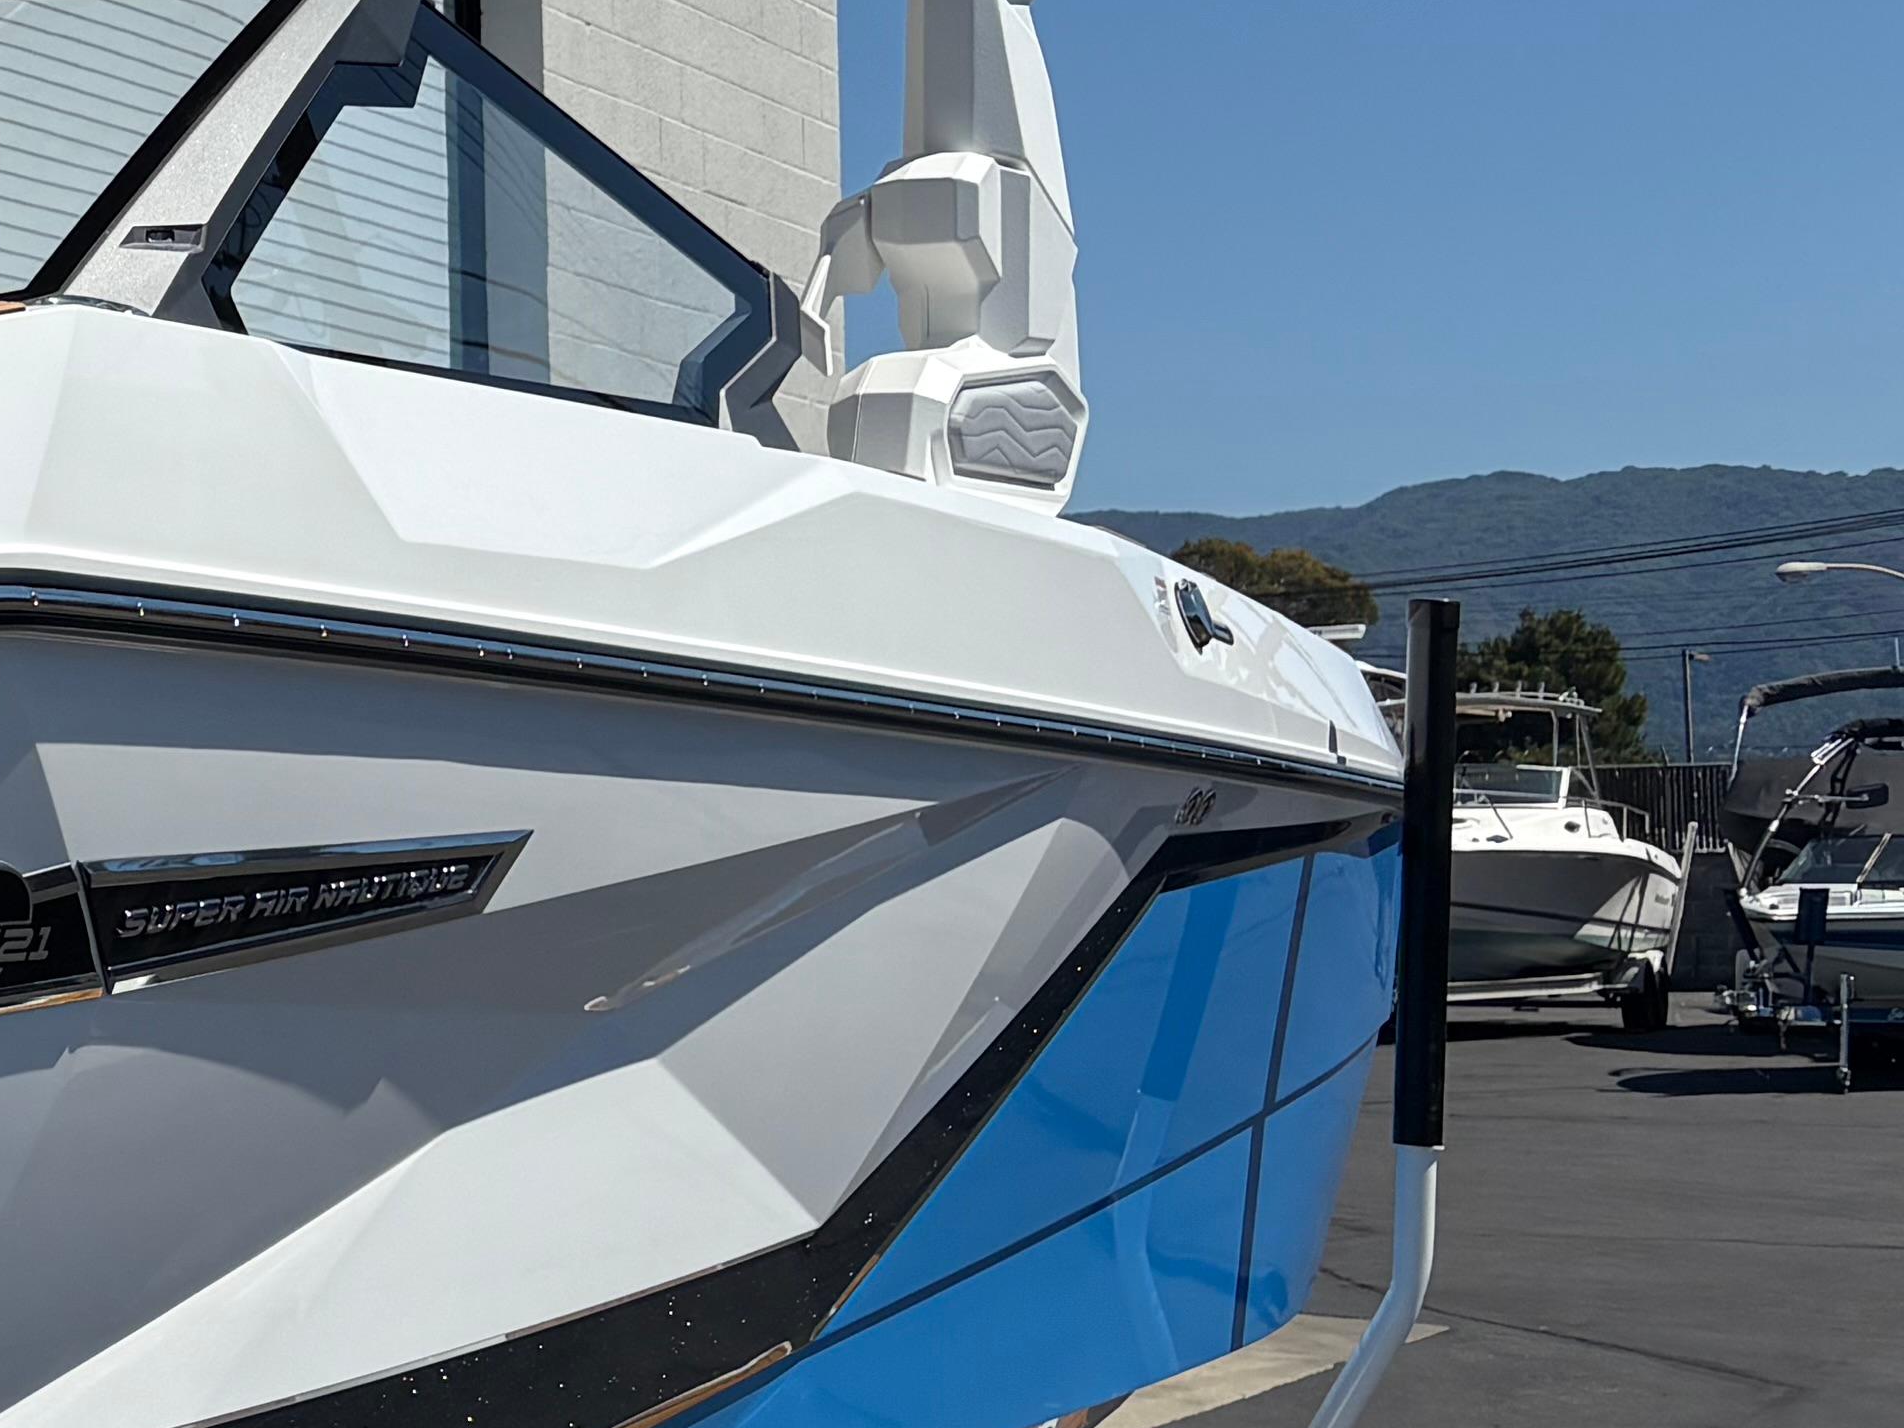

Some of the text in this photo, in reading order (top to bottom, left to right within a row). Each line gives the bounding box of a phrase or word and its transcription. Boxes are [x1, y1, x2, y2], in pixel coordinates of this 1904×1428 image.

[117, 863, 470, 939] SUPER AIR NAUTIQUE
